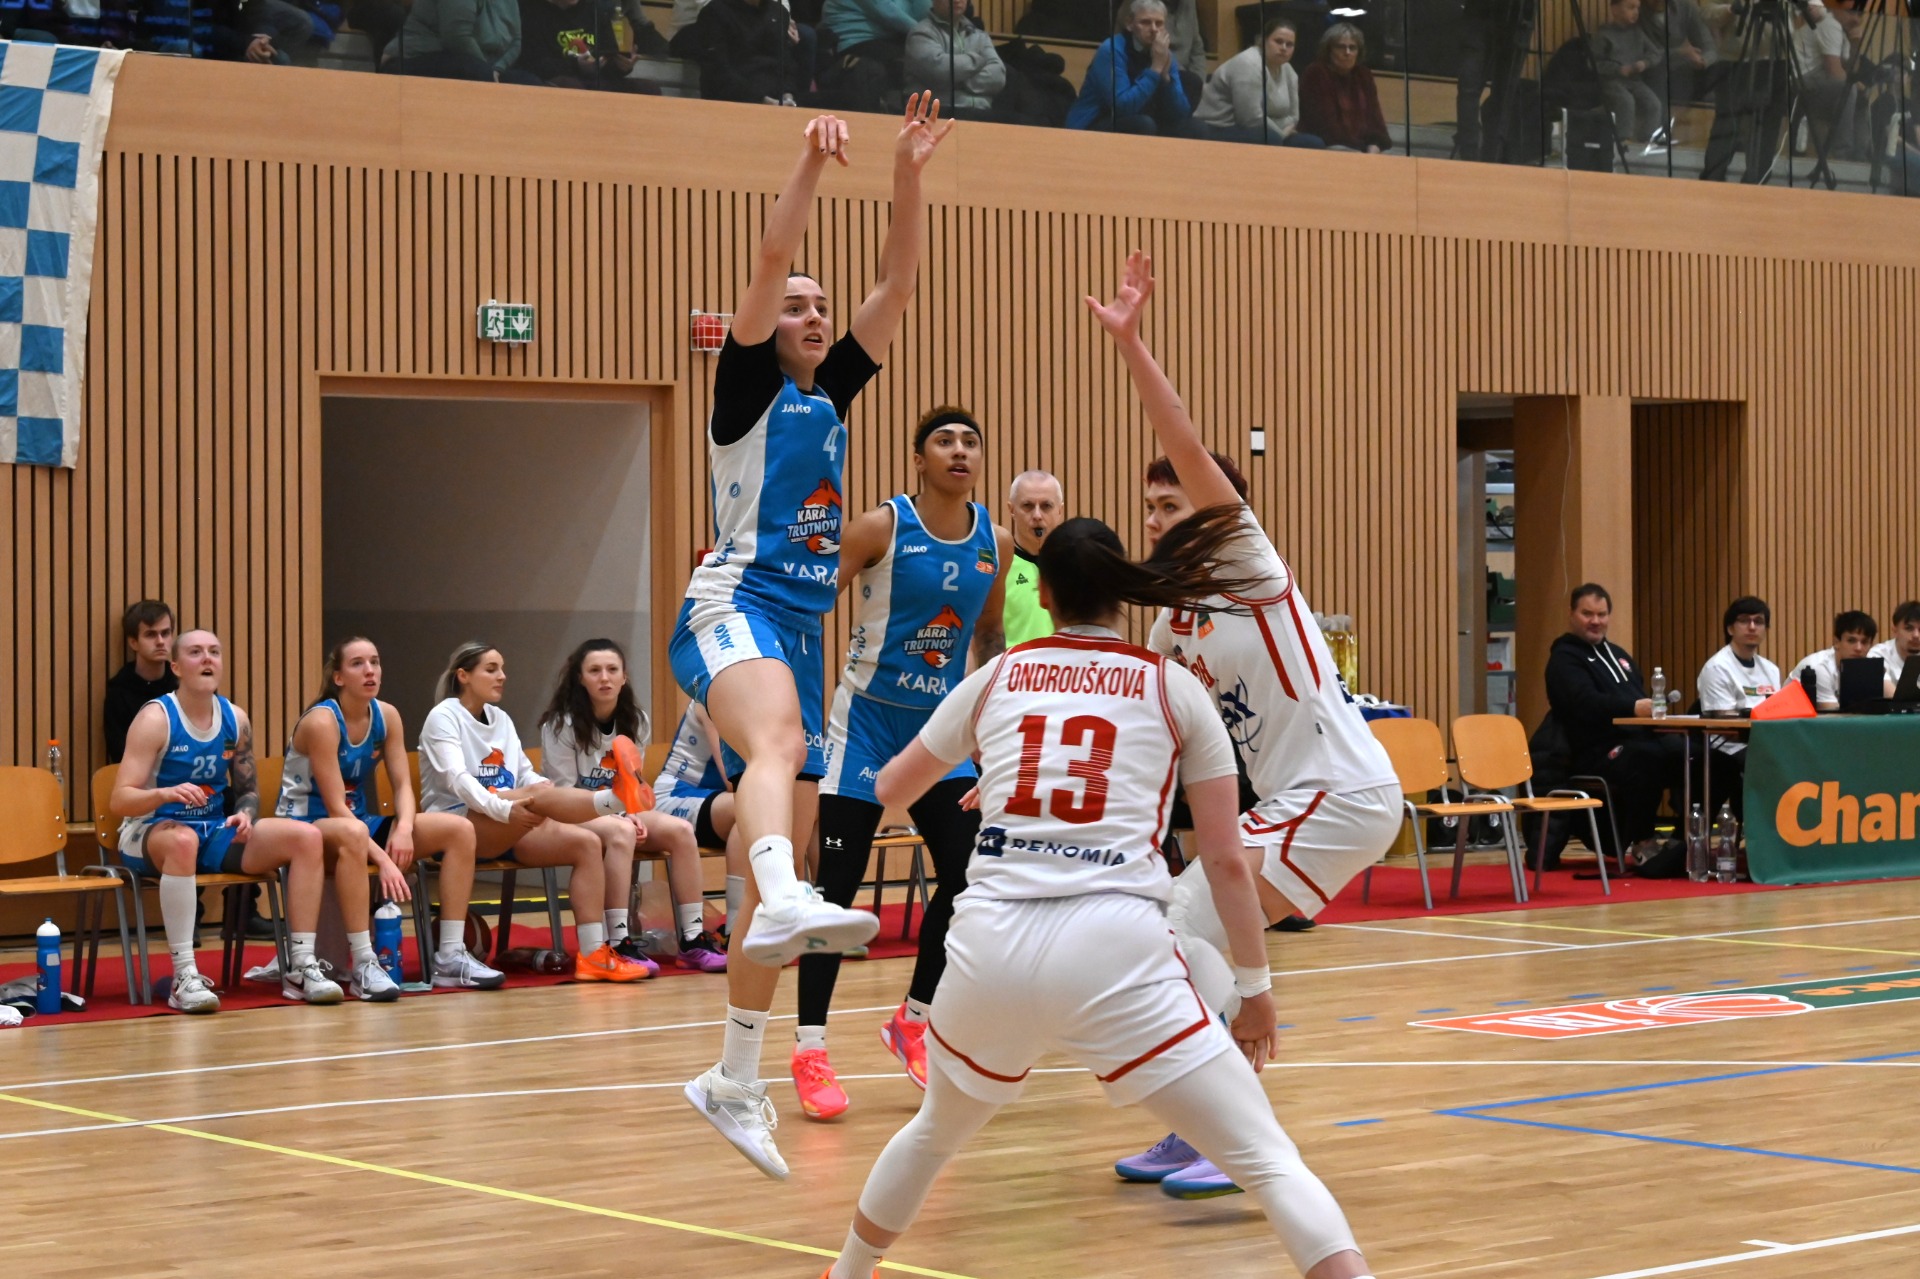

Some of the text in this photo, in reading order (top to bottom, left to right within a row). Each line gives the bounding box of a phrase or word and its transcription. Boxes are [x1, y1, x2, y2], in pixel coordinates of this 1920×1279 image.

[781, 403, 812, 414] JAKO
[822, 425, 840, 462] 4
[787, 518, 838, 538] TRUTNOV
[797, 507, 827, 524] KARA
[902, 545, 928, 553] JAKO
[942, 561, 960, 591] 2
[714, 624, 735, 651] JAKO
[904, 637, 955, 651] TRUTNOV
[917, 627, 947, 639] KARA
[896, 671, 948, 695] KARA
[1008, 660, 1147, 700] ONDROUŠKOVÁ
[191, 754, 217, 779] 23
[1004, 715, 1117, 824] 13
[1776, 780, 1920, 848] Chan
[1010, 838, 1127, 867] RENOMIA
